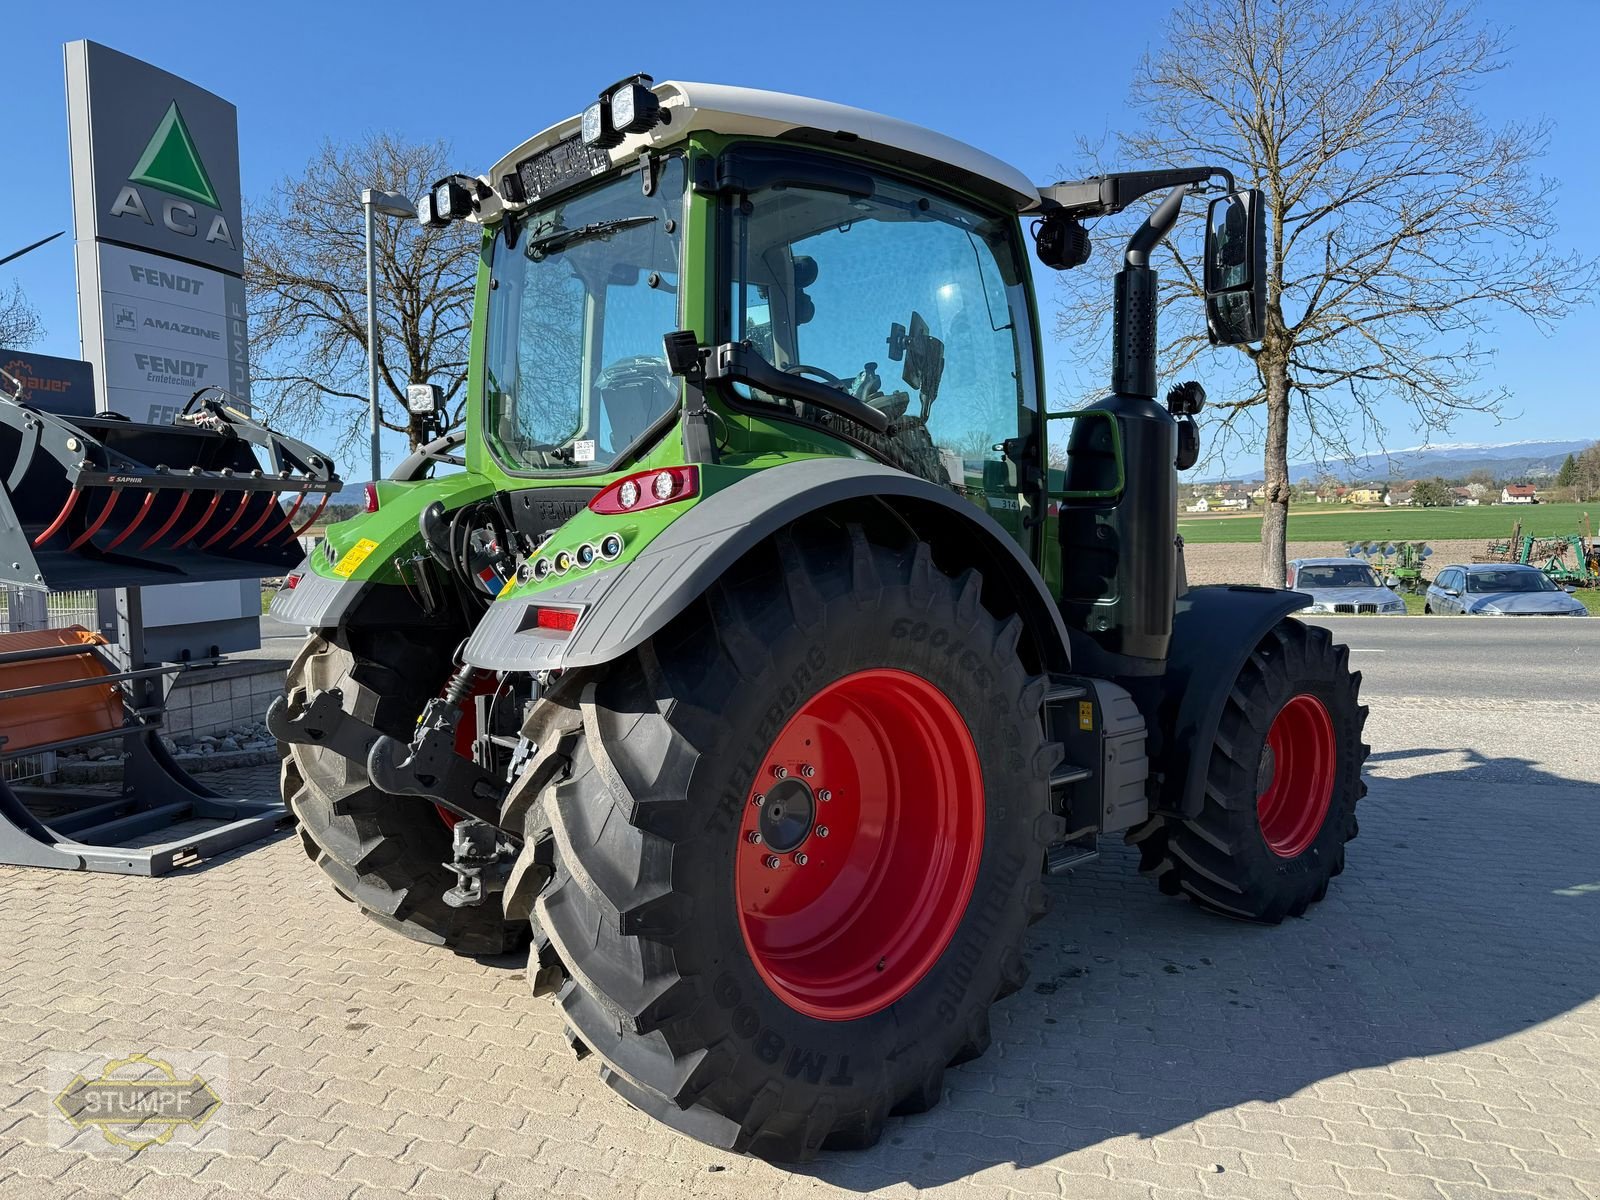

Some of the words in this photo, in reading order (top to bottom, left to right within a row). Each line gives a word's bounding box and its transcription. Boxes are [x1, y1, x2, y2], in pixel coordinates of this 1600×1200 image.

[109, 186, 237, 250] ACA
[129, 264, 204, 296] FENDT
[143, 317, 221, 341] AMAZONE
[134, 353, 209, 379] FENDT
[146, 372, 197, 388] Erntetechnik
[116, 476, 143, 484] SAPHIR
[1002, 499, 1017, 510] 314
[713, 972, 855, 1086] TM800
